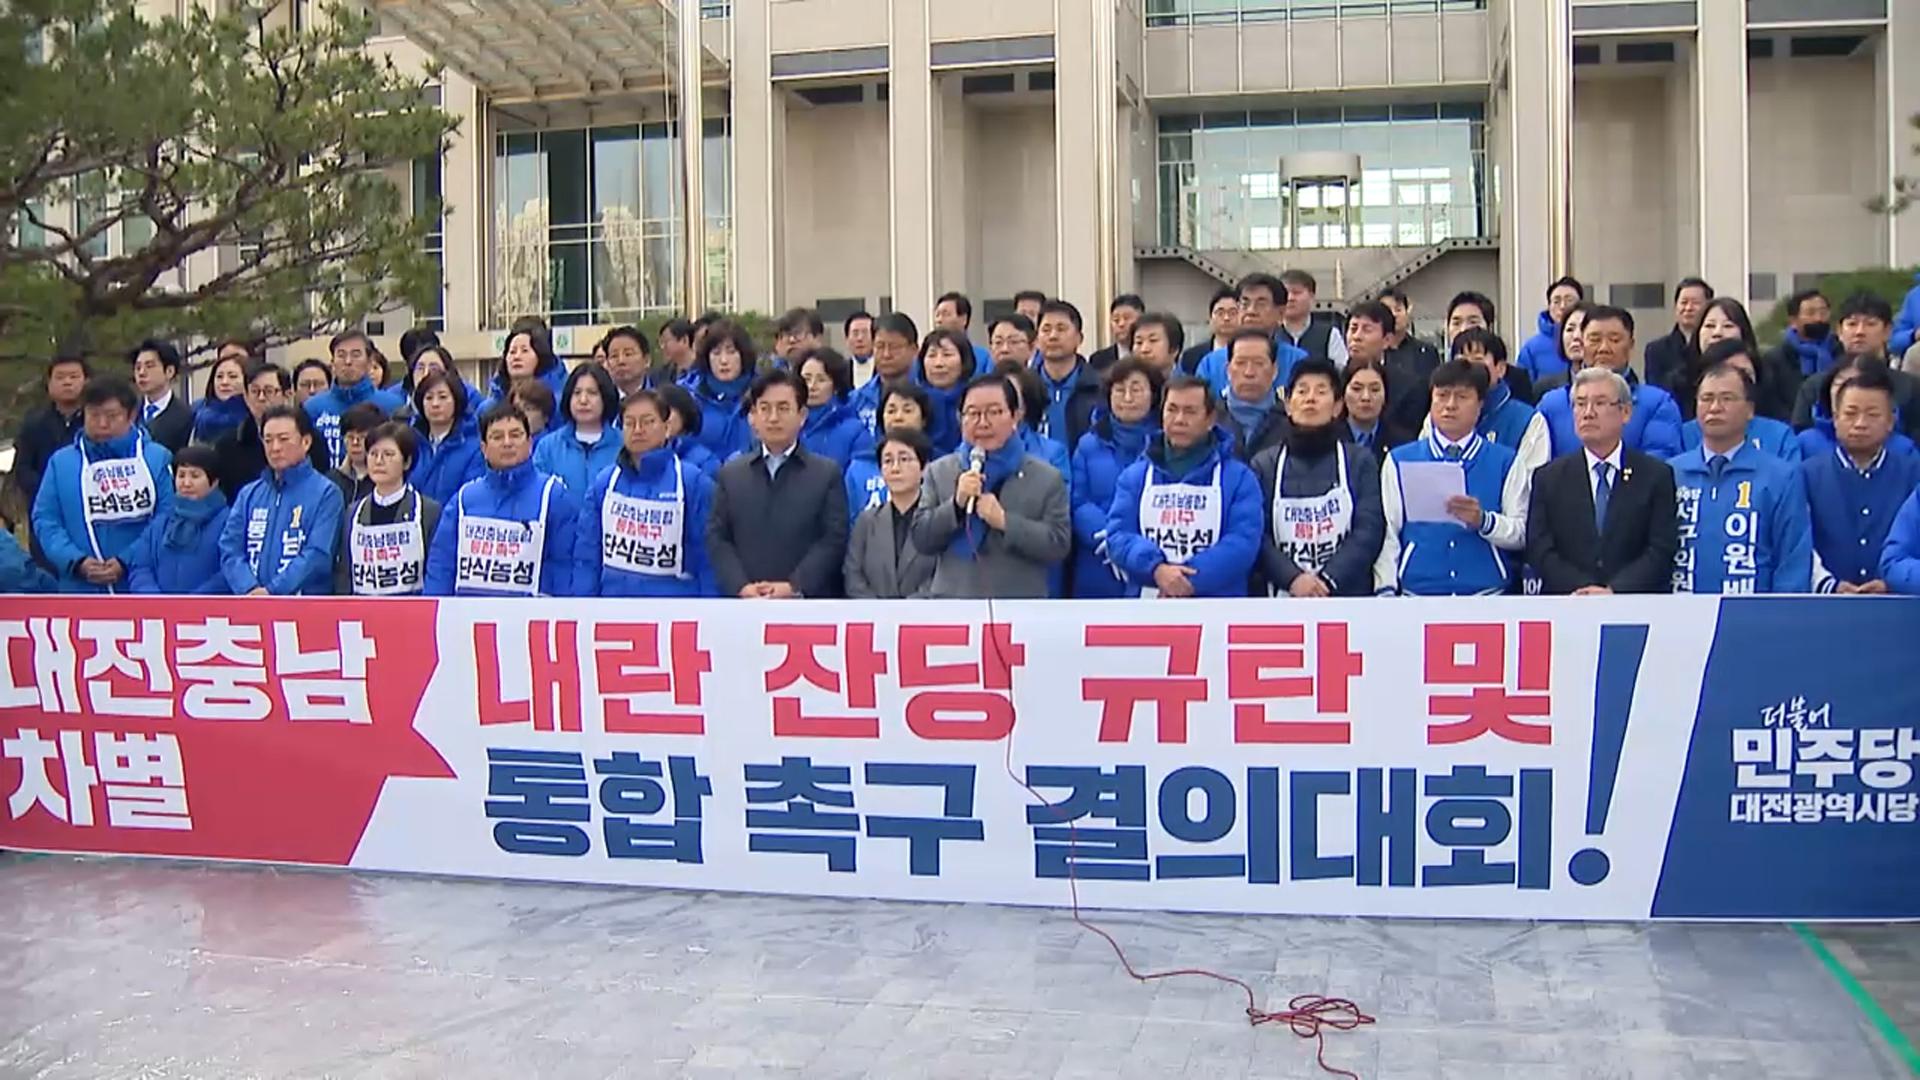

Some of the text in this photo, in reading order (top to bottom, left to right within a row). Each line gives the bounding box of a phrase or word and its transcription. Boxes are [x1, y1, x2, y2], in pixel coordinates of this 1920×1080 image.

[88, 487, 151, 514] 단식농성
[1735, 481, 1751, 509] 1
[290, 505, 302, 528] 1
[605, 533, 677, 568] 단식농성
[353, 561, 419, 588] 단식농성
[460, 556, 535, 585] 단식농성
[0, 617, 377, 724] 대전충남
[473, 620, 1552, 745] 내란 잔당 규탄 및
[1760, 696, 1831, 732] 더불어
[1732, 728, 1920, 788] 민주당
[3, 728, 193, 829] 차별
[484, 748, 713, 864] 통합
[744, 755, 985, 876] 촉구
[1730, 793, 1920, 822] 대전광역시당
